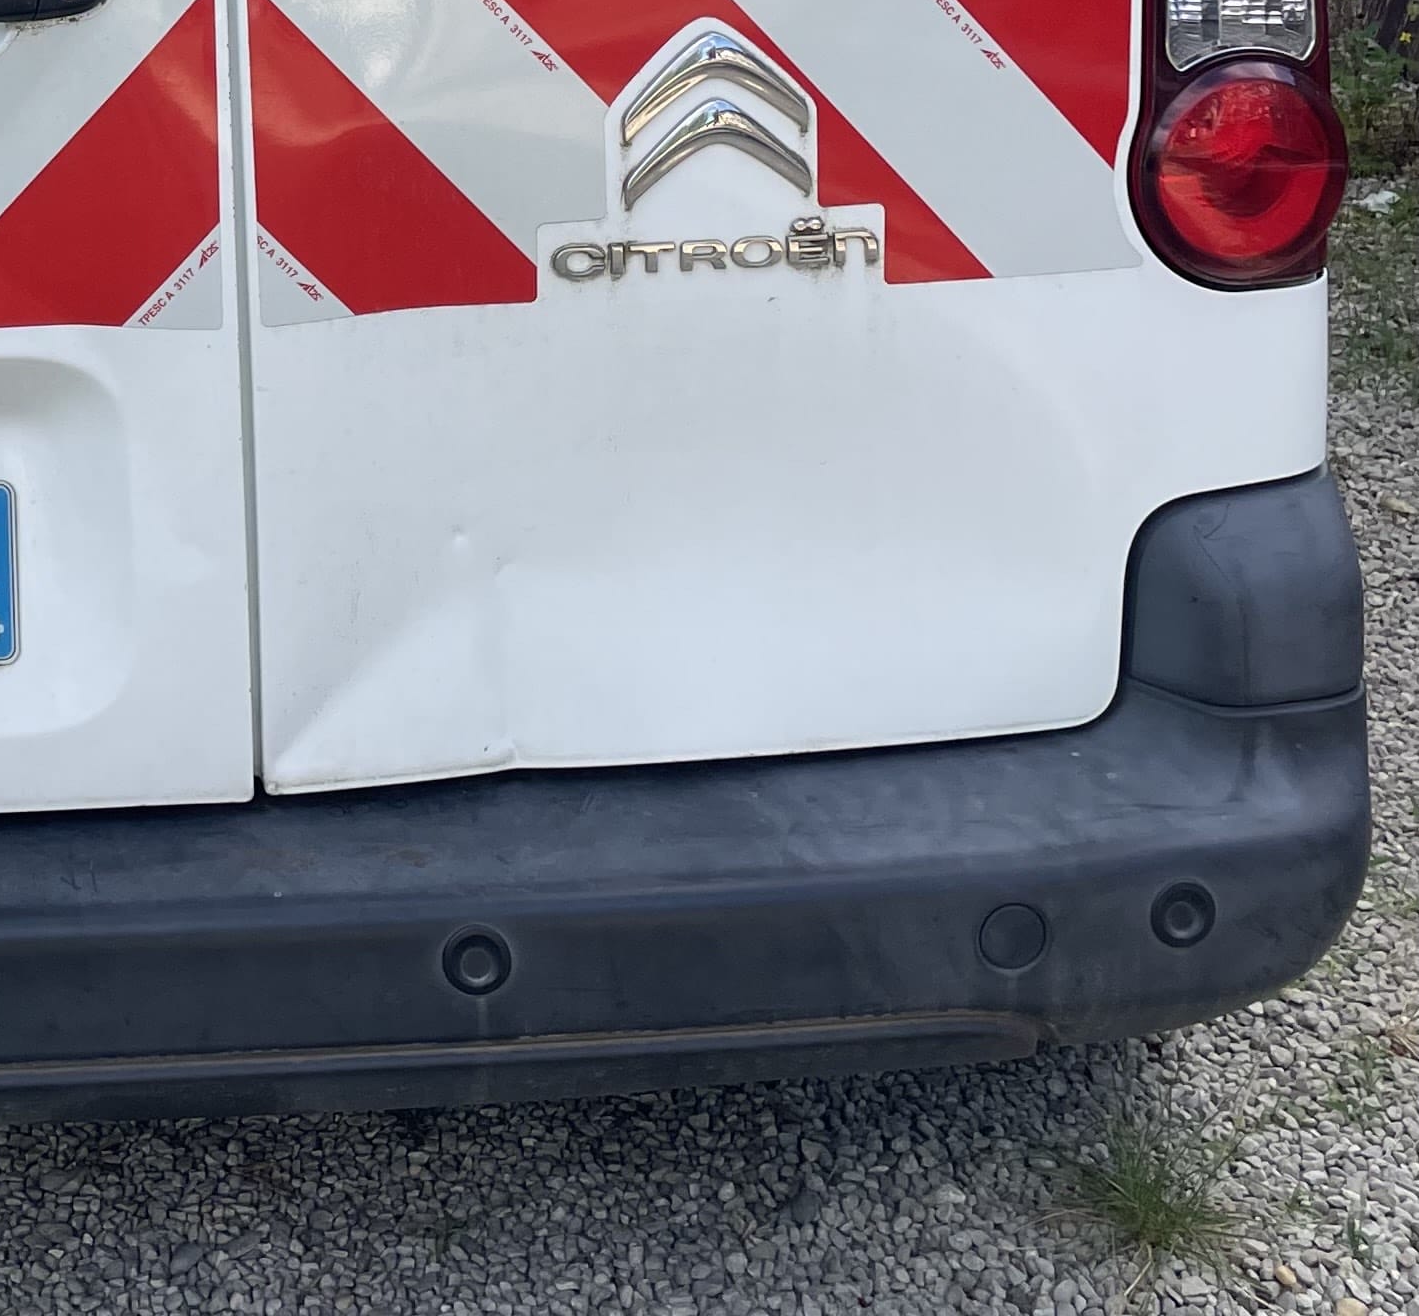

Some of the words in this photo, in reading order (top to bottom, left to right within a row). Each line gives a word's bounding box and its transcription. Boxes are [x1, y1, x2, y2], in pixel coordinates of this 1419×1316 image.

[510, 24, 533, 45] 3117
[961, 23, 983, 44] 3117
[275, 257, 299, 278] 3117
[138, 297, 167, 326] TPESC
[173, 267, 195, 291] 3117
